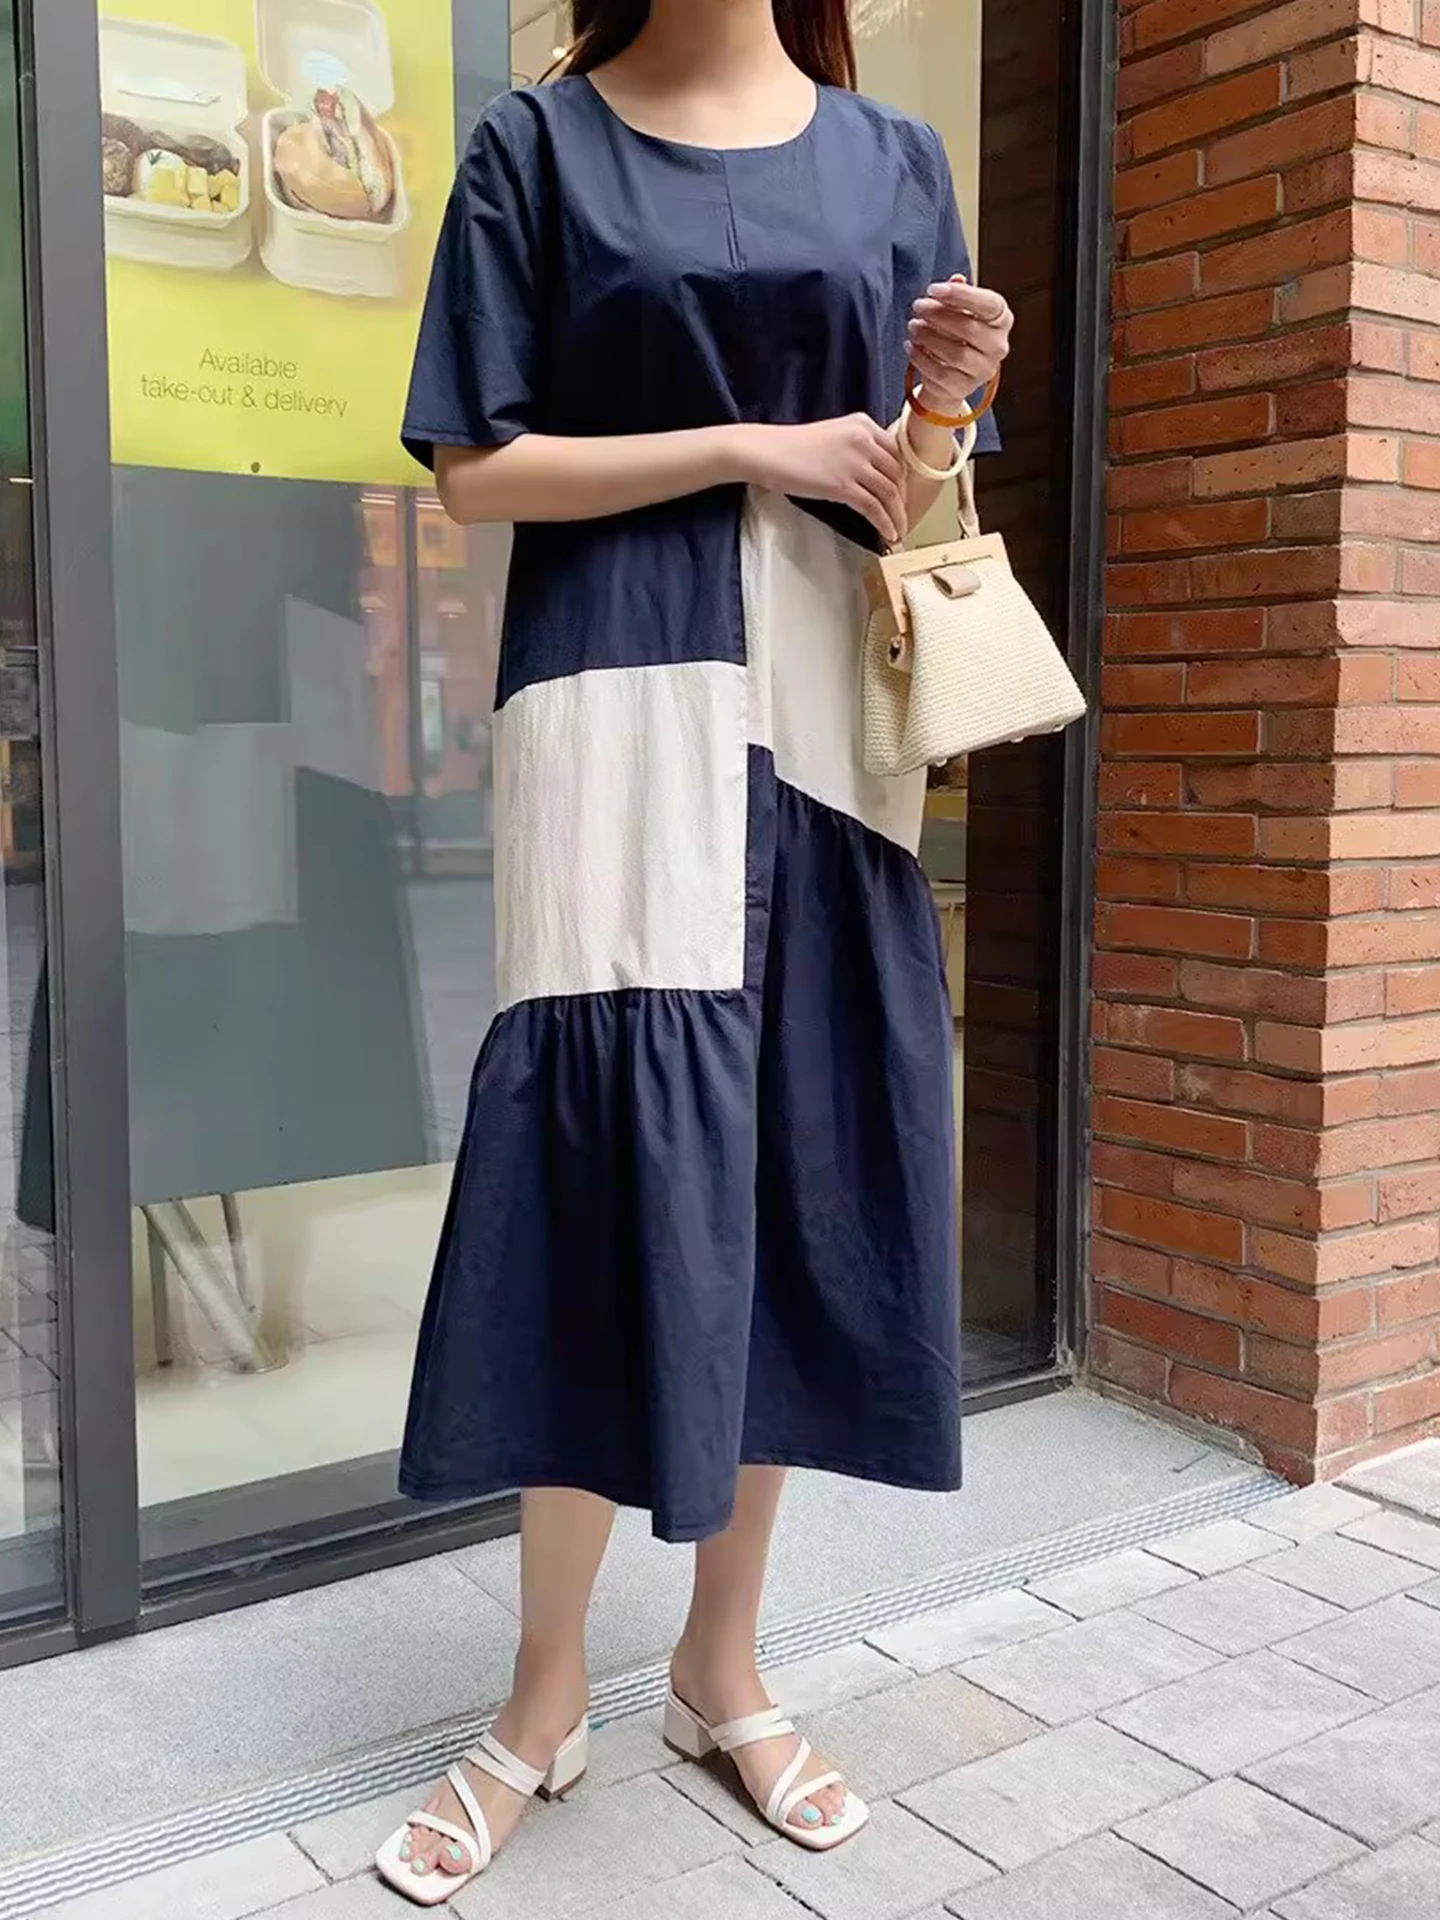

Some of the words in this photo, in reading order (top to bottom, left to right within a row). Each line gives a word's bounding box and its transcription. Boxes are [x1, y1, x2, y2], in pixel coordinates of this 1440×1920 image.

[200, 348, 297, 379] Available
[141, 375, 233, 406] take-out
[241, 384, 257, 408] &
[264, 388, 348, 417] delivery
